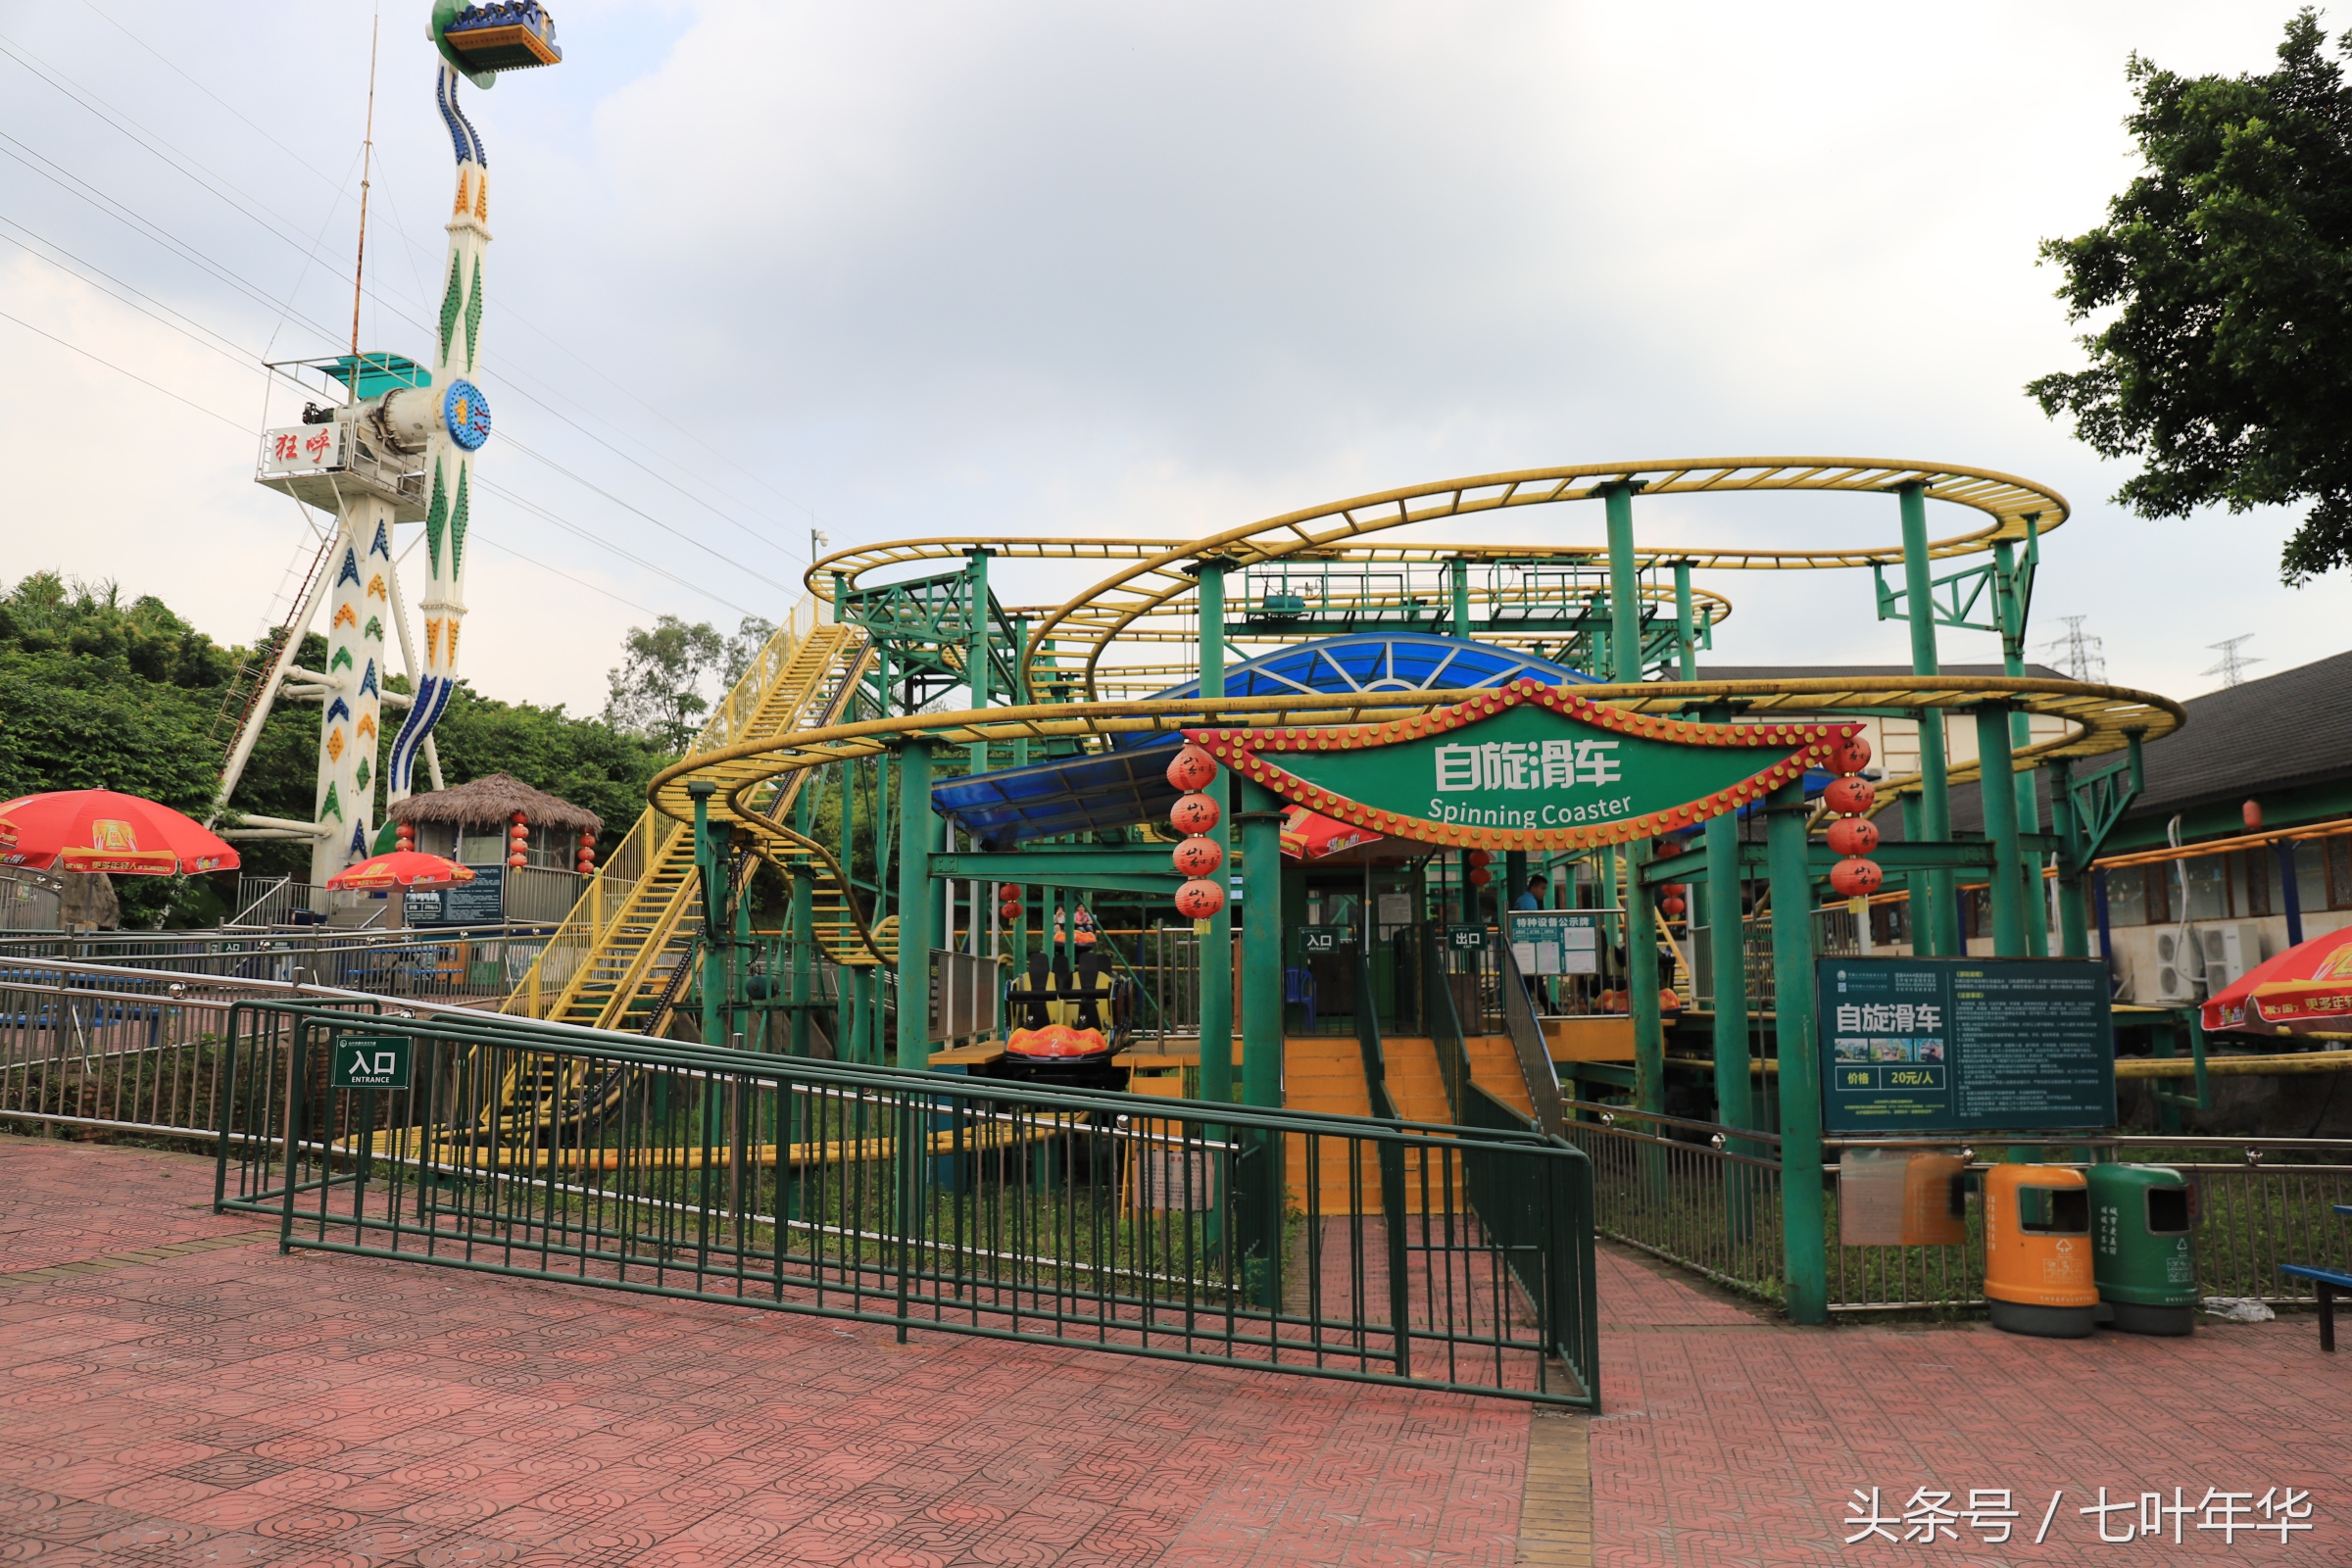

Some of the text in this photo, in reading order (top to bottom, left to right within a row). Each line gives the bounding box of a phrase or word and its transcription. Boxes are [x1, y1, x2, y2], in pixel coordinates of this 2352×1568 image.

[275, 428, 331, 464] 狂呼
[1435, 740, 1622, 791] 自旋滑车
[1428, 795, 1632, 830] Spinning Coaster
[92, 861, 137, 870] 更多年轻人
[1517, 917, 1590, 927] 特种设备公示牌
[1307, 934, 1332, 947] 入口
[1456, 932, 1480, 945] 出口
[226, 943, 240, 952] 入口
[1837, 1003, 1942, 1033] 自旋滑车
[1052, 1039, 1058, 1048] 2
[349, 1050, 396, 1075] 入口
[1847, 1071, 1934, 1085] 价格 20元/人
